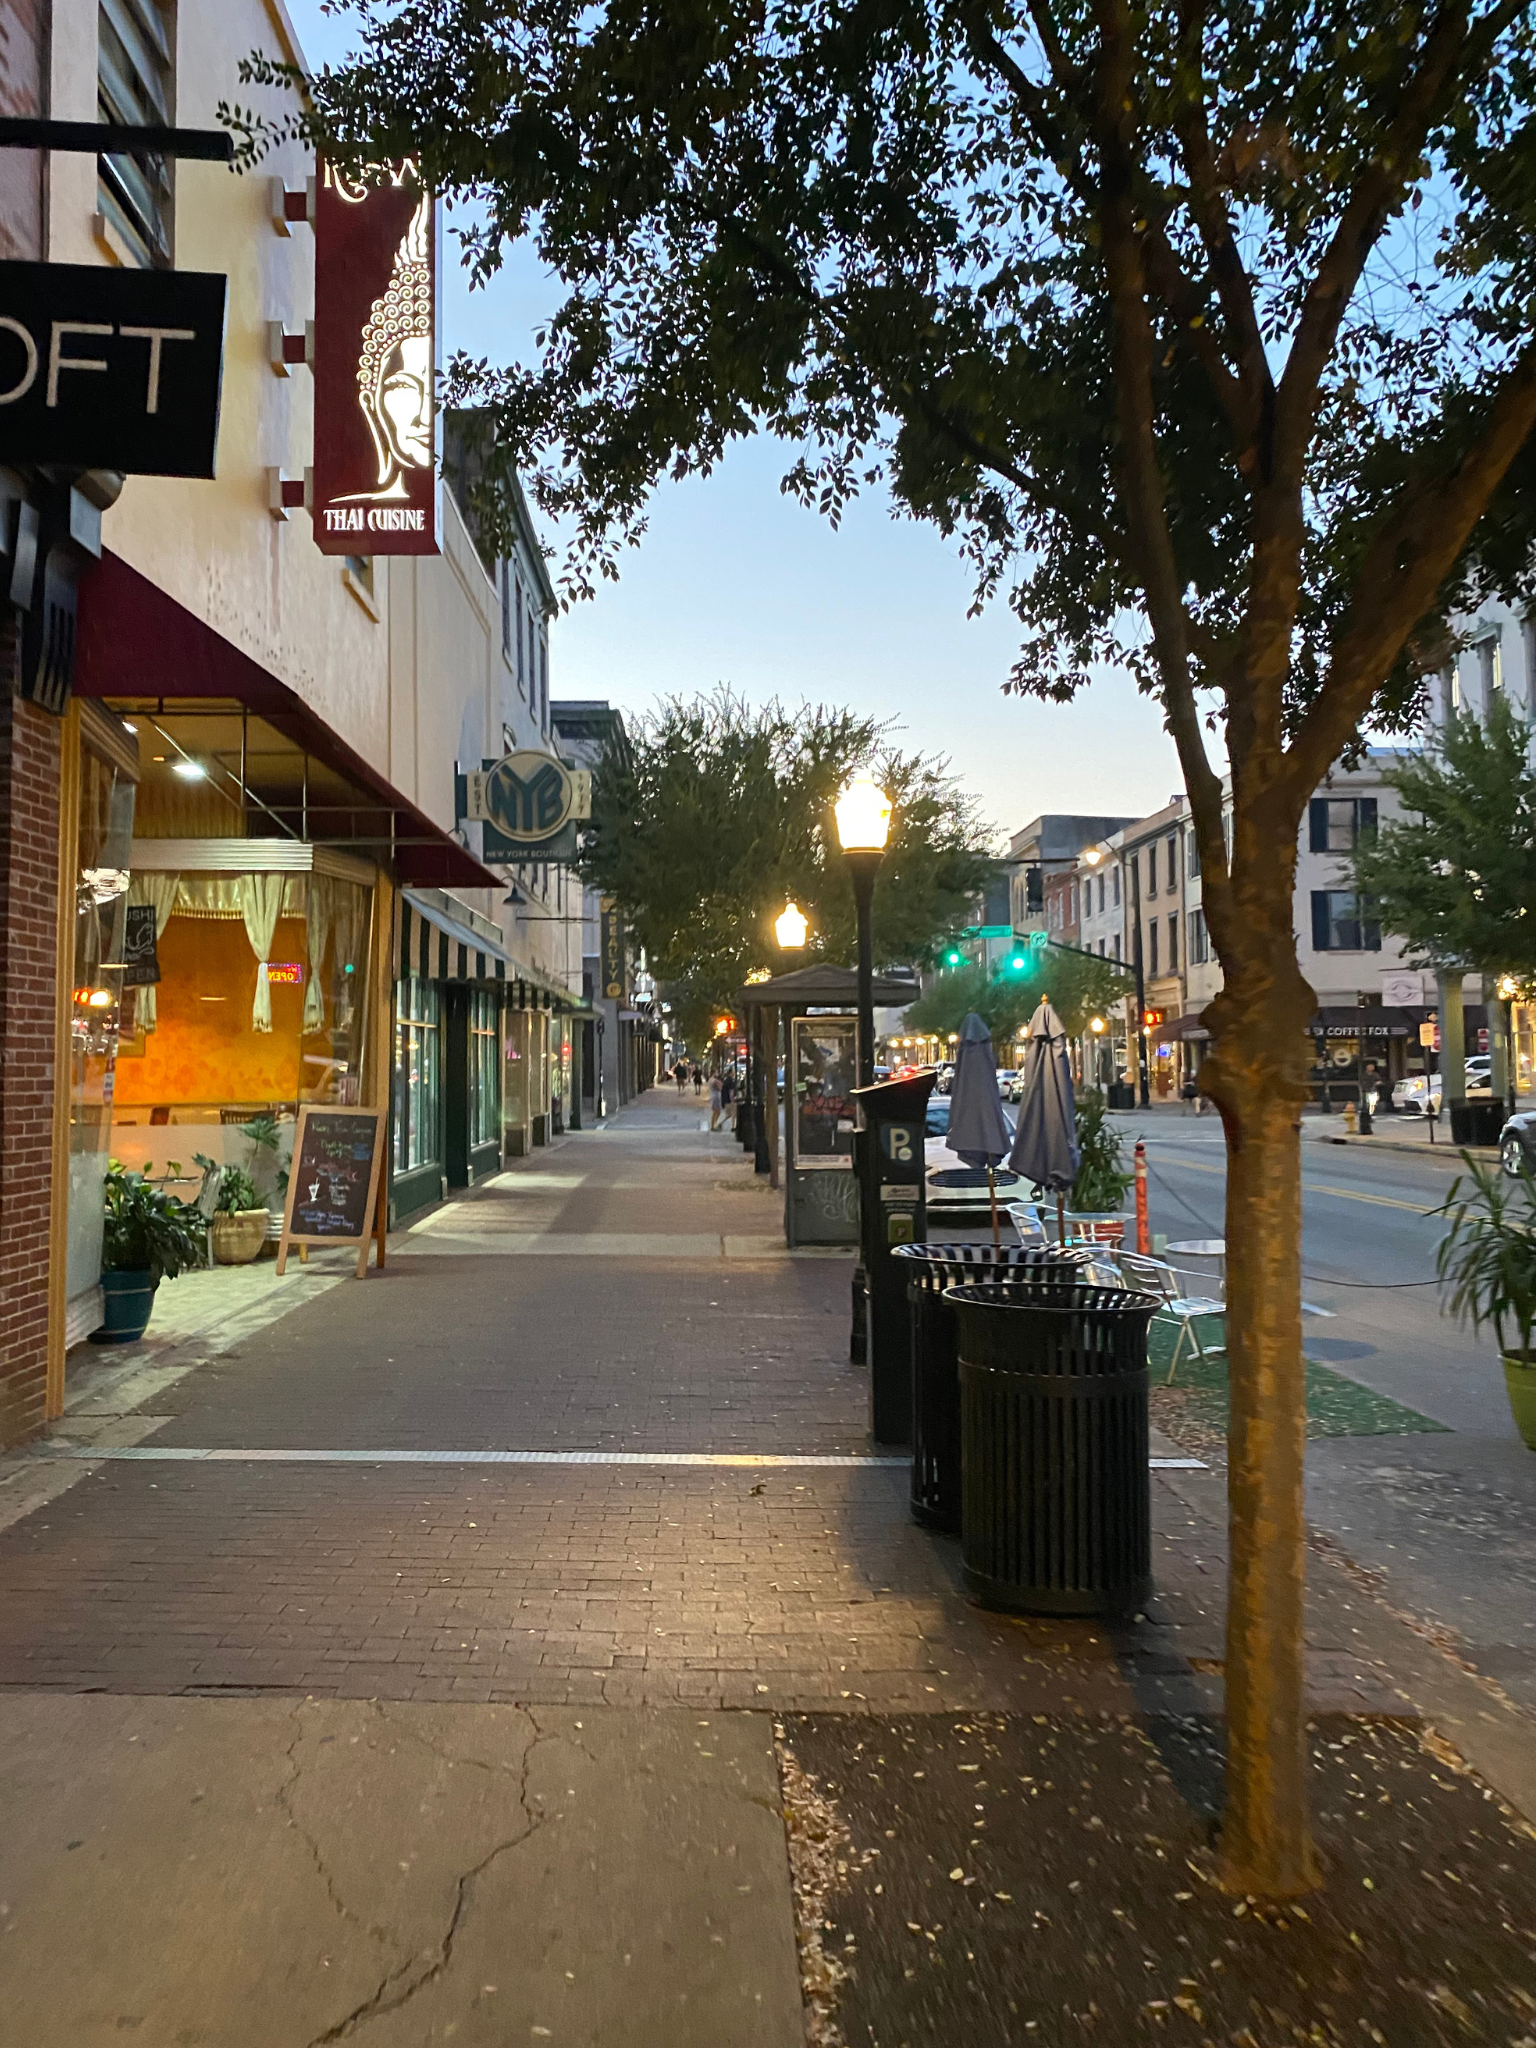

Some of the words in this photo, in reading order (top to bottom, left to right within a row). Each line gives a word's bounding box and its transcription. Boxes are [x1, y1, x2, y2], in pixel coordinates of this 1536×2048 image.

[323, 509, 363, 531] THAI
[368, 509, 425, 532] CUISINE
[491, 763, 564, 831] NYB
[507, 850, 529, 858] YORK
[1369, 1027, 1389, 1036] FOX
